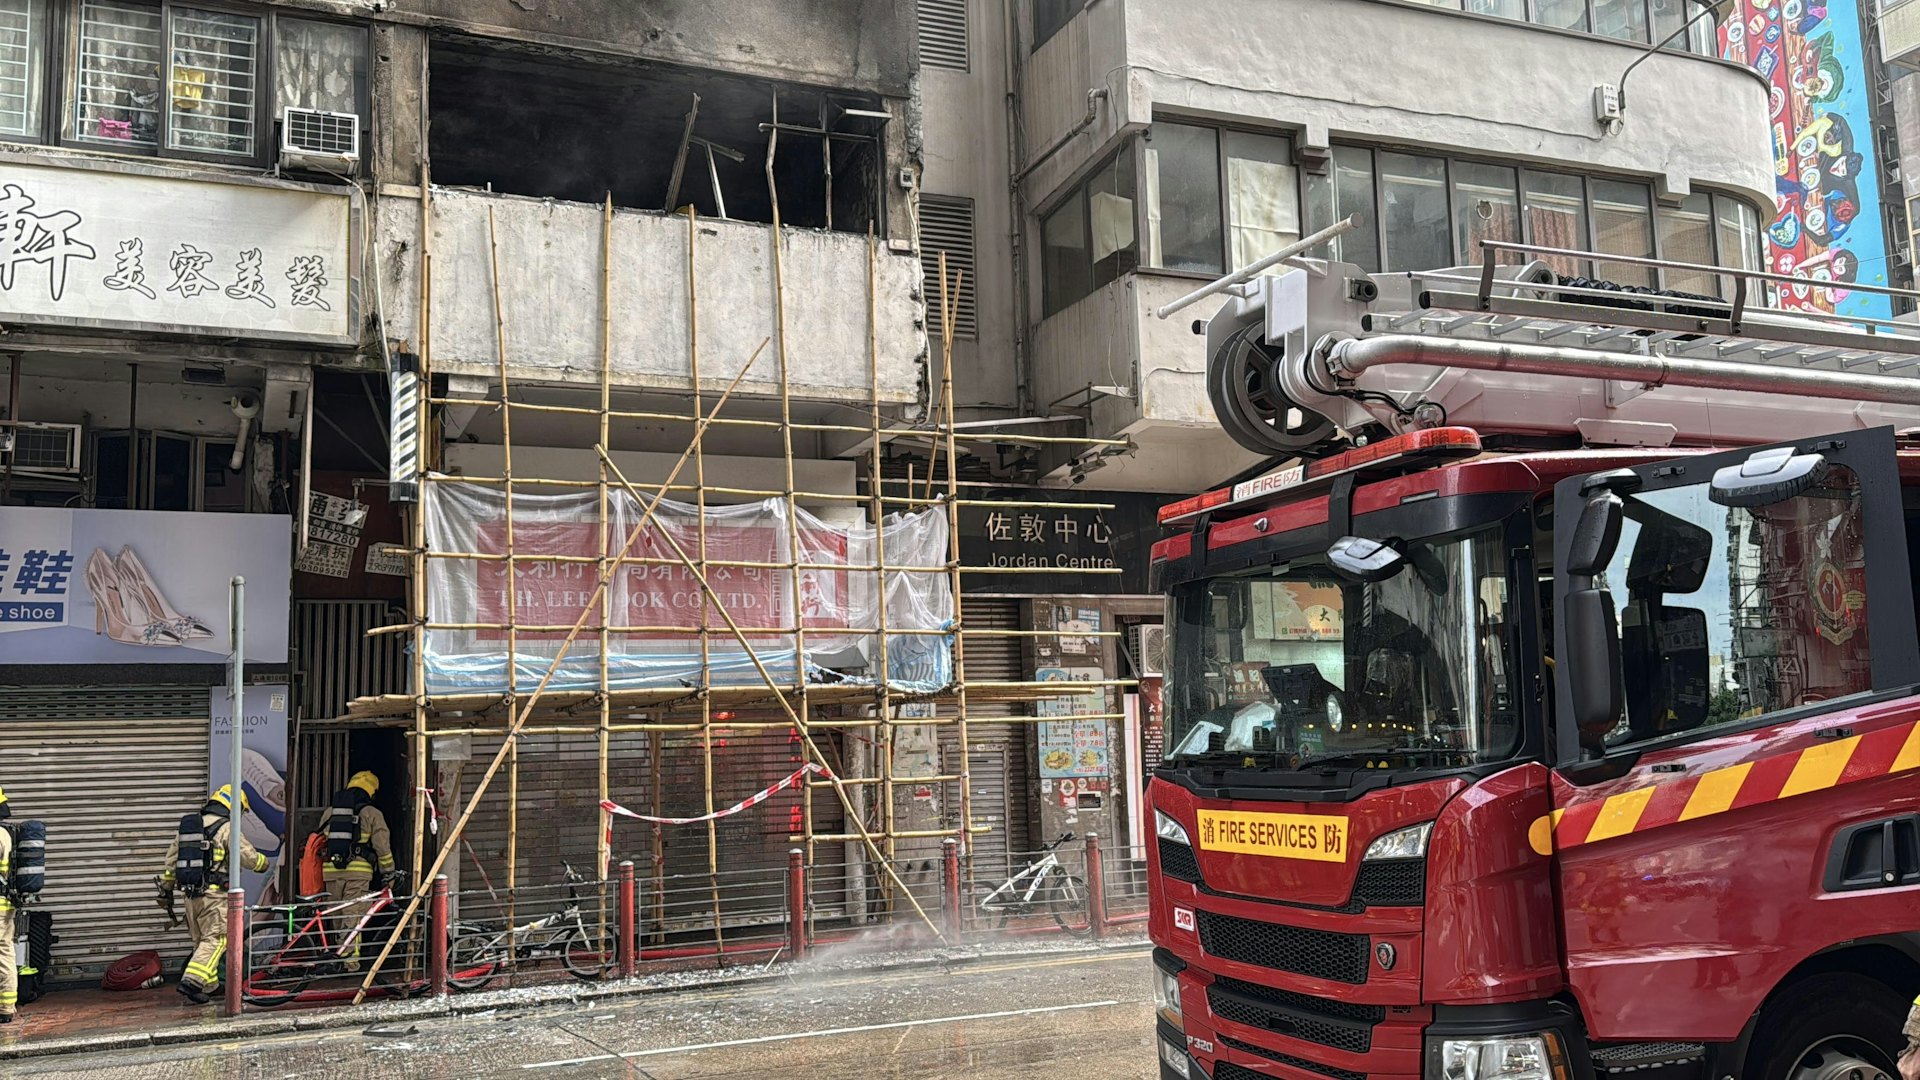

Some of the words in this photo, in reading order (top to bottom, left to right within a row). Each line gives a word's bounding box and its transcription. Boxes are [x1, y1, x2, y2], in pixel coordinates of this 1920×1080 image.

[104, 237, 331, 312] 美容美髮
[1236, 483, 1251, 498] 消
[1253, 474, 1282, 494] FIRE
[1283, 469, 1302, 485] 防
[308, 527, 356, 546] 817280
[985, 511, 1113, 544] 佐敦中心
[987, 552, 1049, 568] Jordan
[1055, 553, 1113, 569] Centre
[0, 549, 74, 595] 鞋
[548, 590, 592, 607] LEE
[9, 605, 55, 619] shoe
[214, 715, 268, 727] FASION
[1203, 817, 1215, 844] 消
[1219, 820, 1246, 844] FIRE
[1249, 822, 1317, 849] SERVICES
[1323, 824, 1342, 854] 防
[1194, 1037, 1214, 1054] 320
